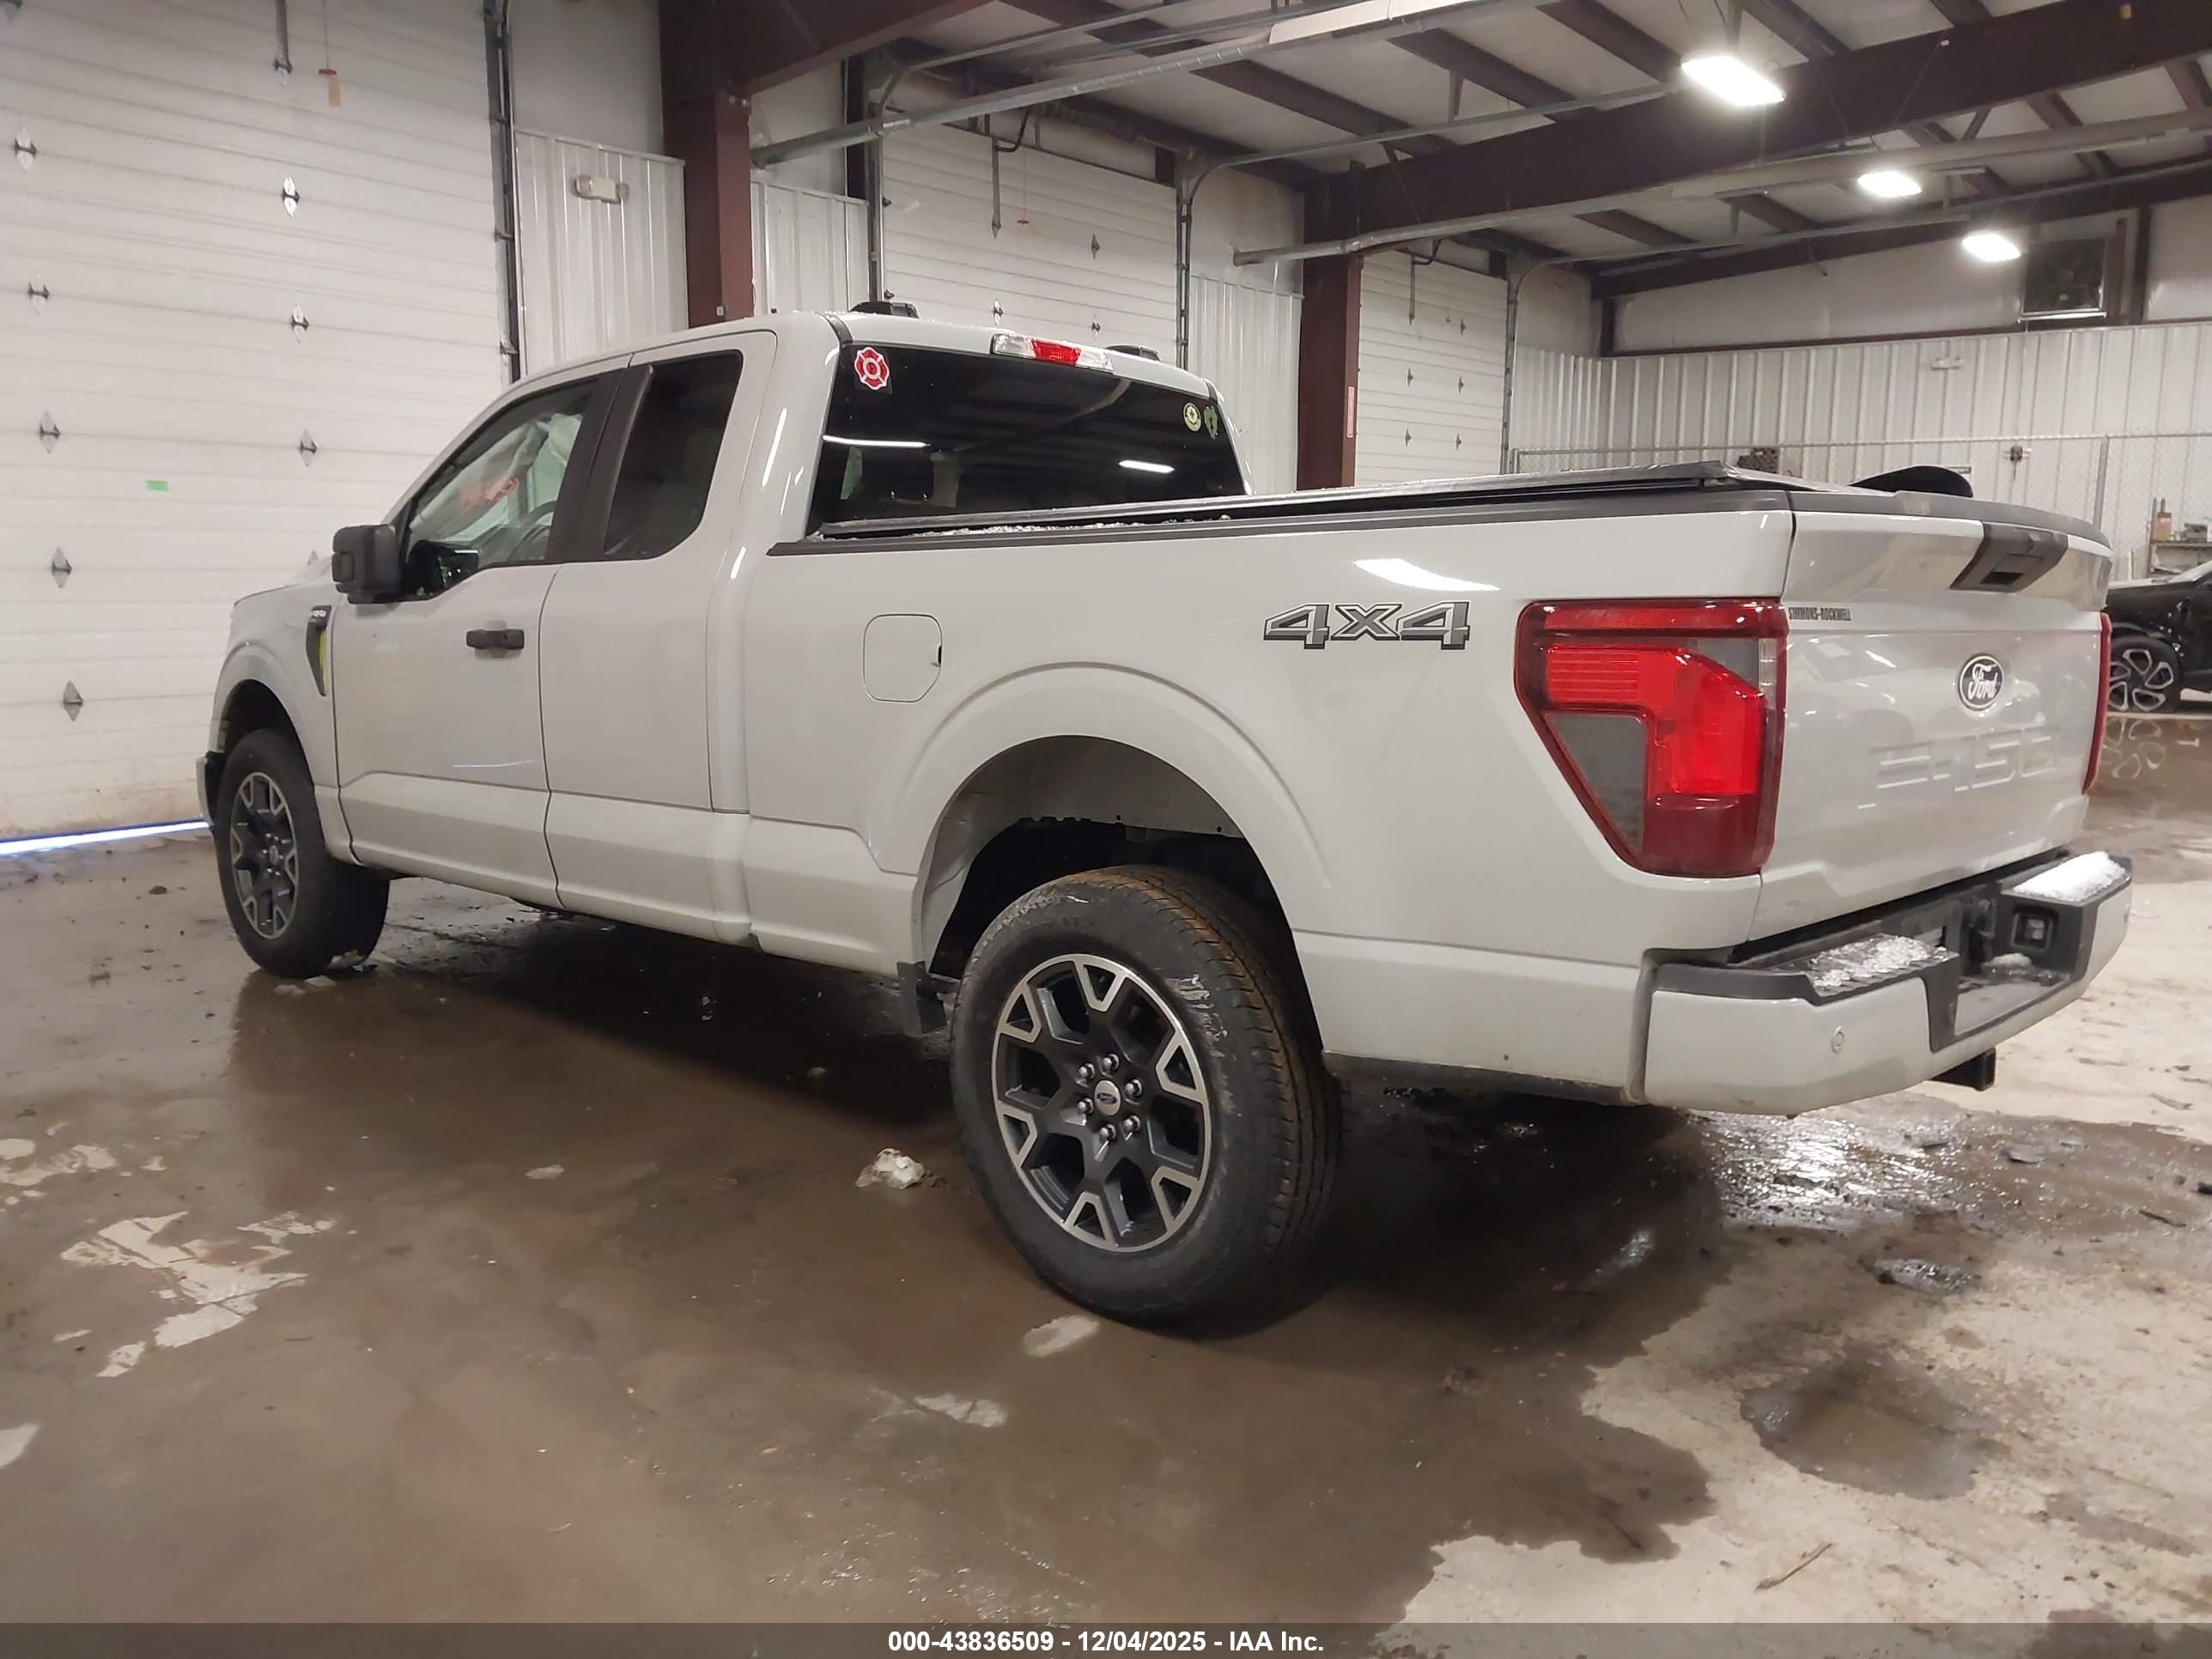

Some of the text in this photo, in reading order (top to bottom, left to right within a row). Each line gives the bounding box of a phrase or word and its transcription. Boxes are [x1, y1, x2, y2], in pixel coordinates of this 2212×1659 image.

[1263, 601, 1470, 650] 4X4
[1788, 606, 1852, 621] SIMMONS-ROCKWELL
[1967, 662, 1999, 700] Ford
